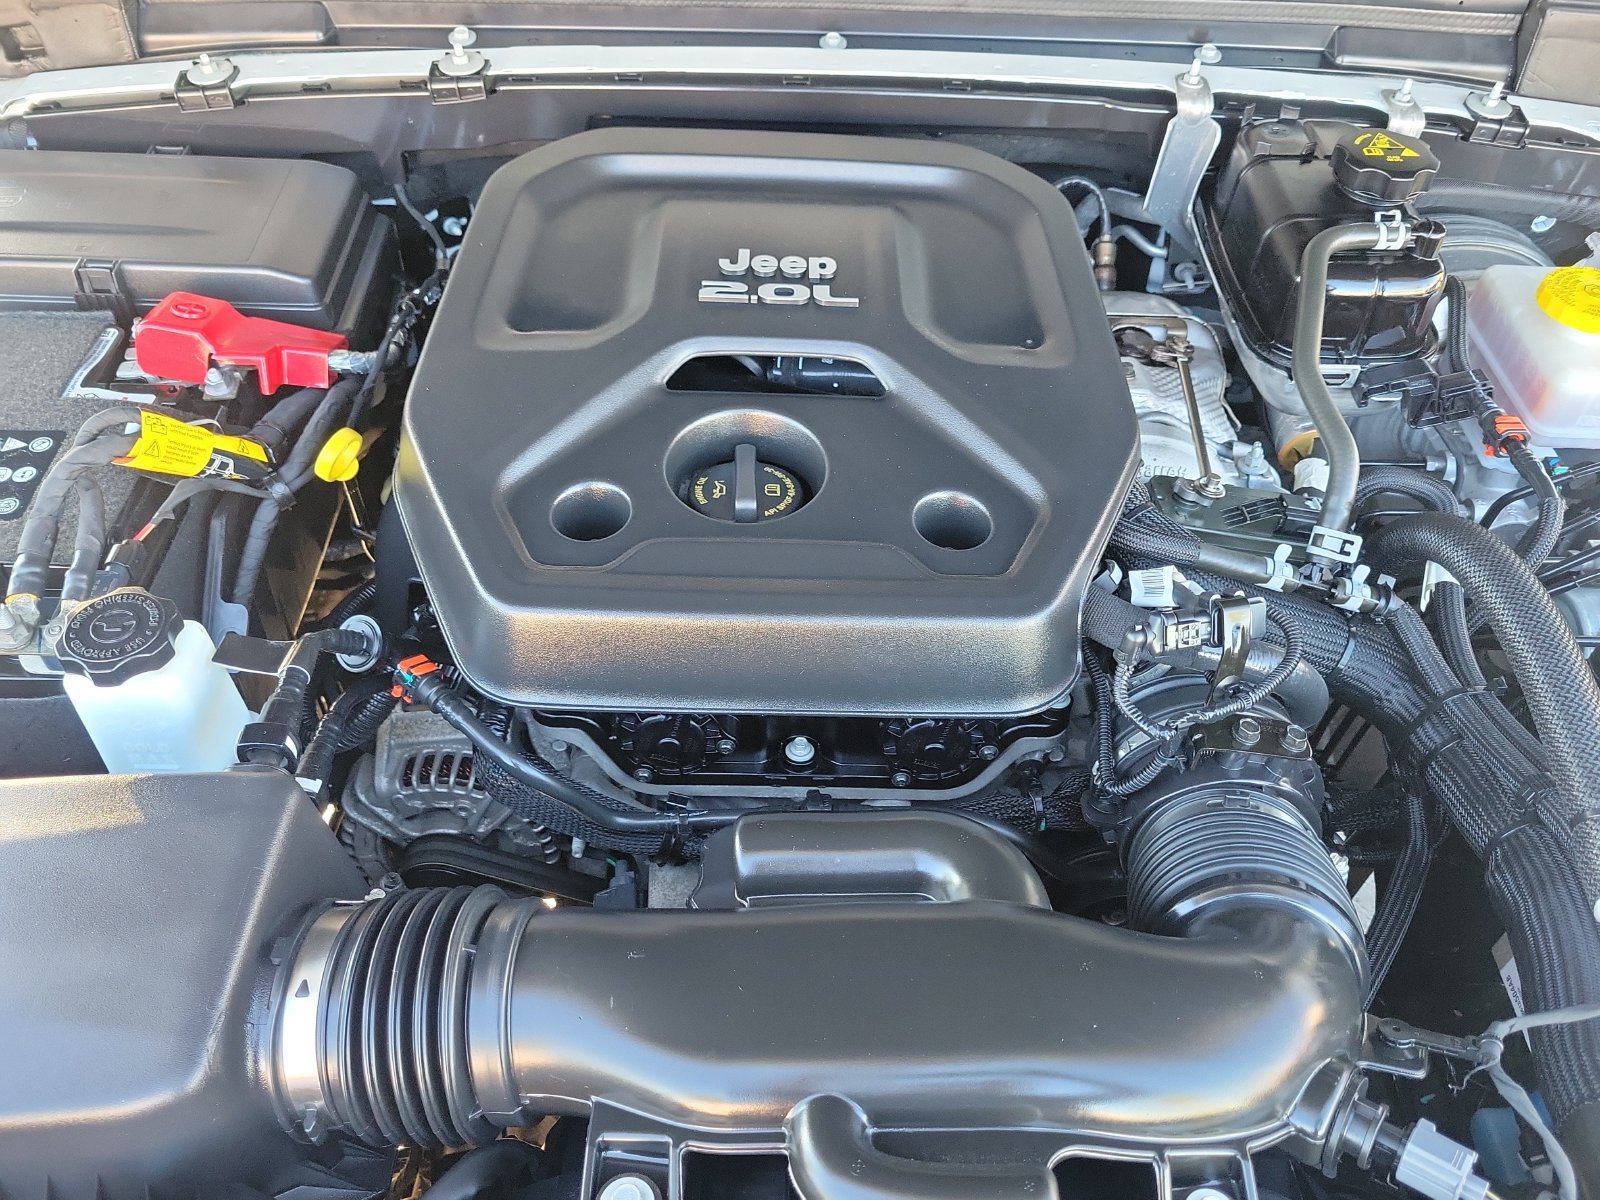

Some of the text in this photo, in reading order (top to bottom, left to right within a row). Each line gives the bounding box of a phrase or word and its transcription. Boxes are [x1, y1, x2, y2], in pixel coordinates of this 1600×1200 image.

[718, 248, 837, 282] Jeep
[698, 280, 860, 308] 2.0L
[694, 476, 708, 504] ENGINE OIL
[764, 508, 778, 516] API
[94, 594, 145, 609] STEERING
[69, 636, 148, 659] USE APPROVED
